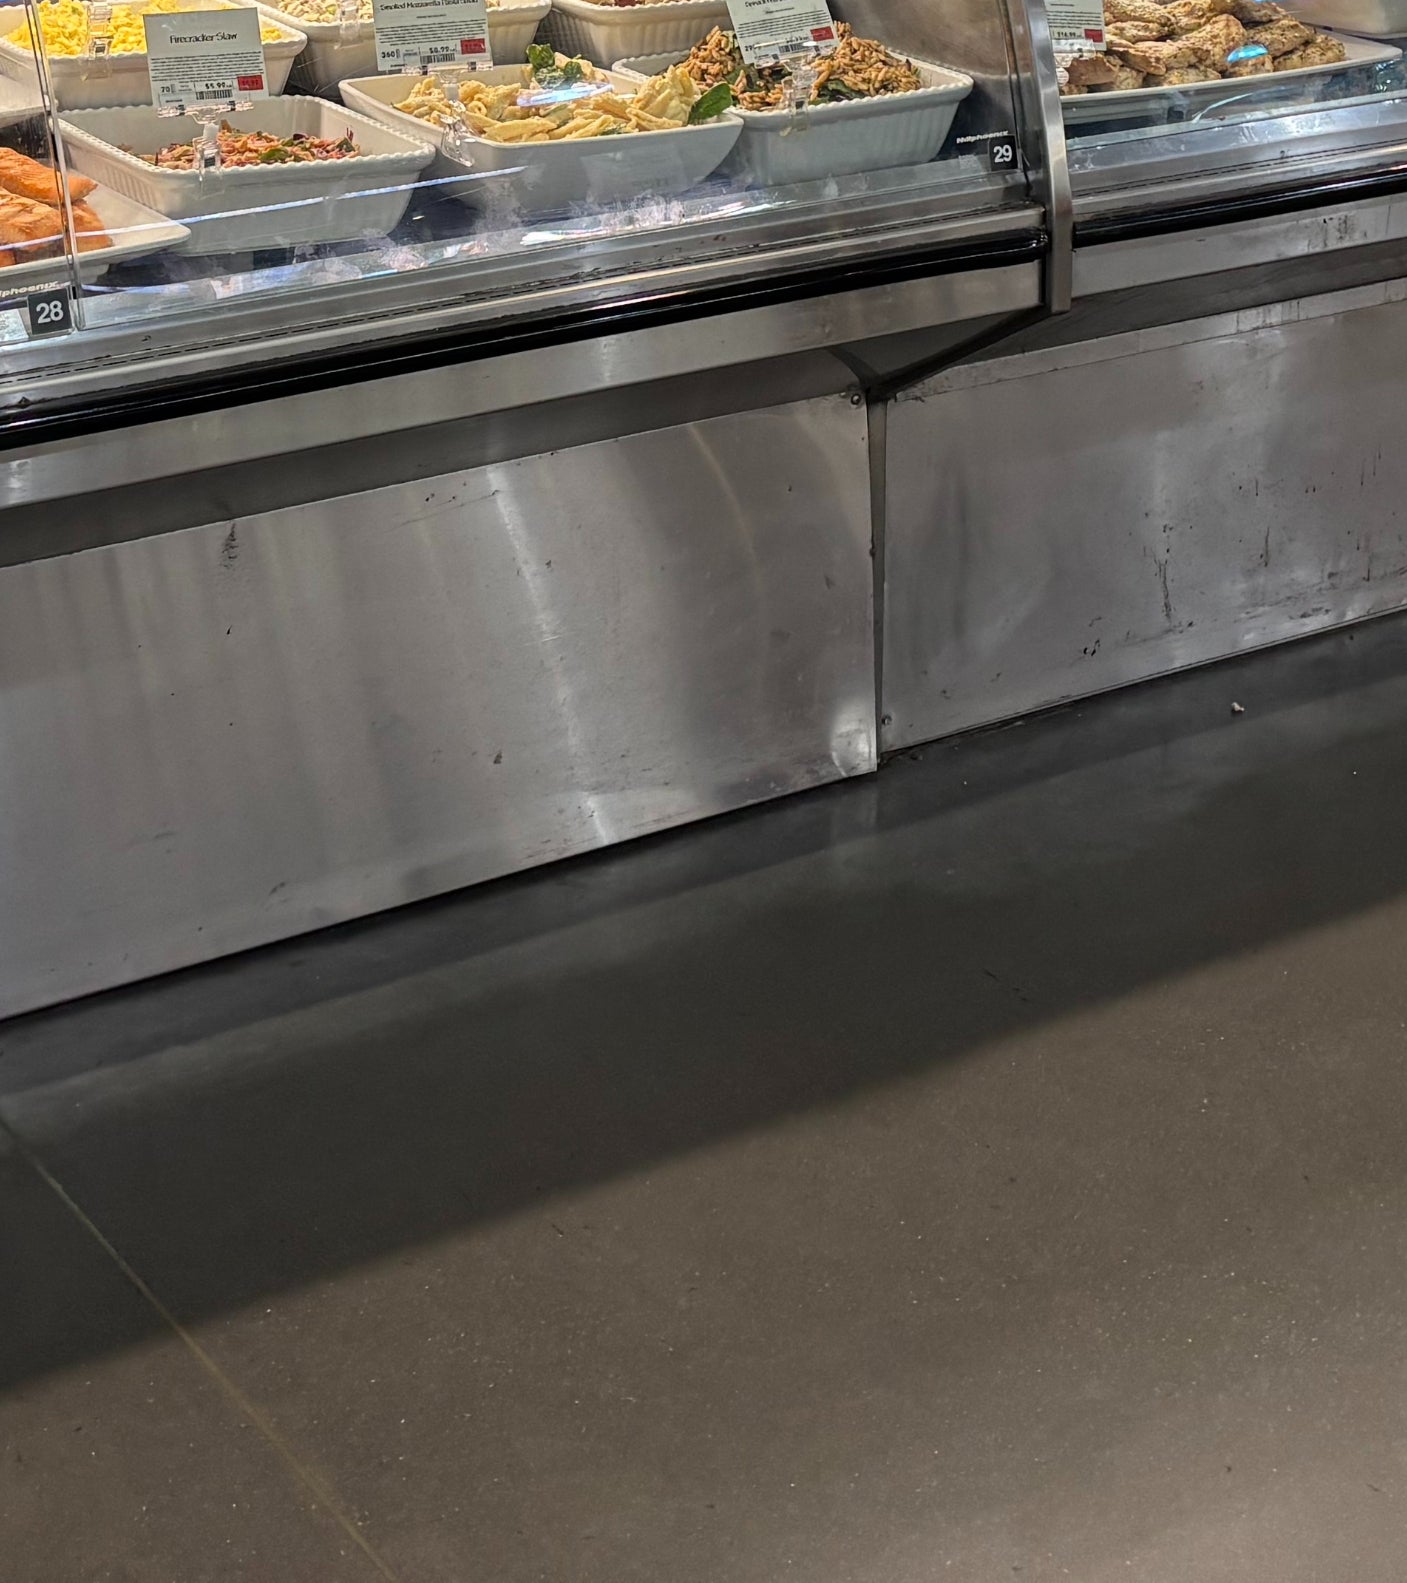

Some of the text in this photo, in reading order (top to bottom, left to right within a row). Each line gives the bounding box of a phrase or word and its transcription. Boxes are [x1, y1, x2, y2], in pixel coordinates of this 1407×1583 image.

[170, 32, 237, 44] Firecracker Slaw
[994, 145, 1012, 163] 29
[36, 300, 64, 324] 28
